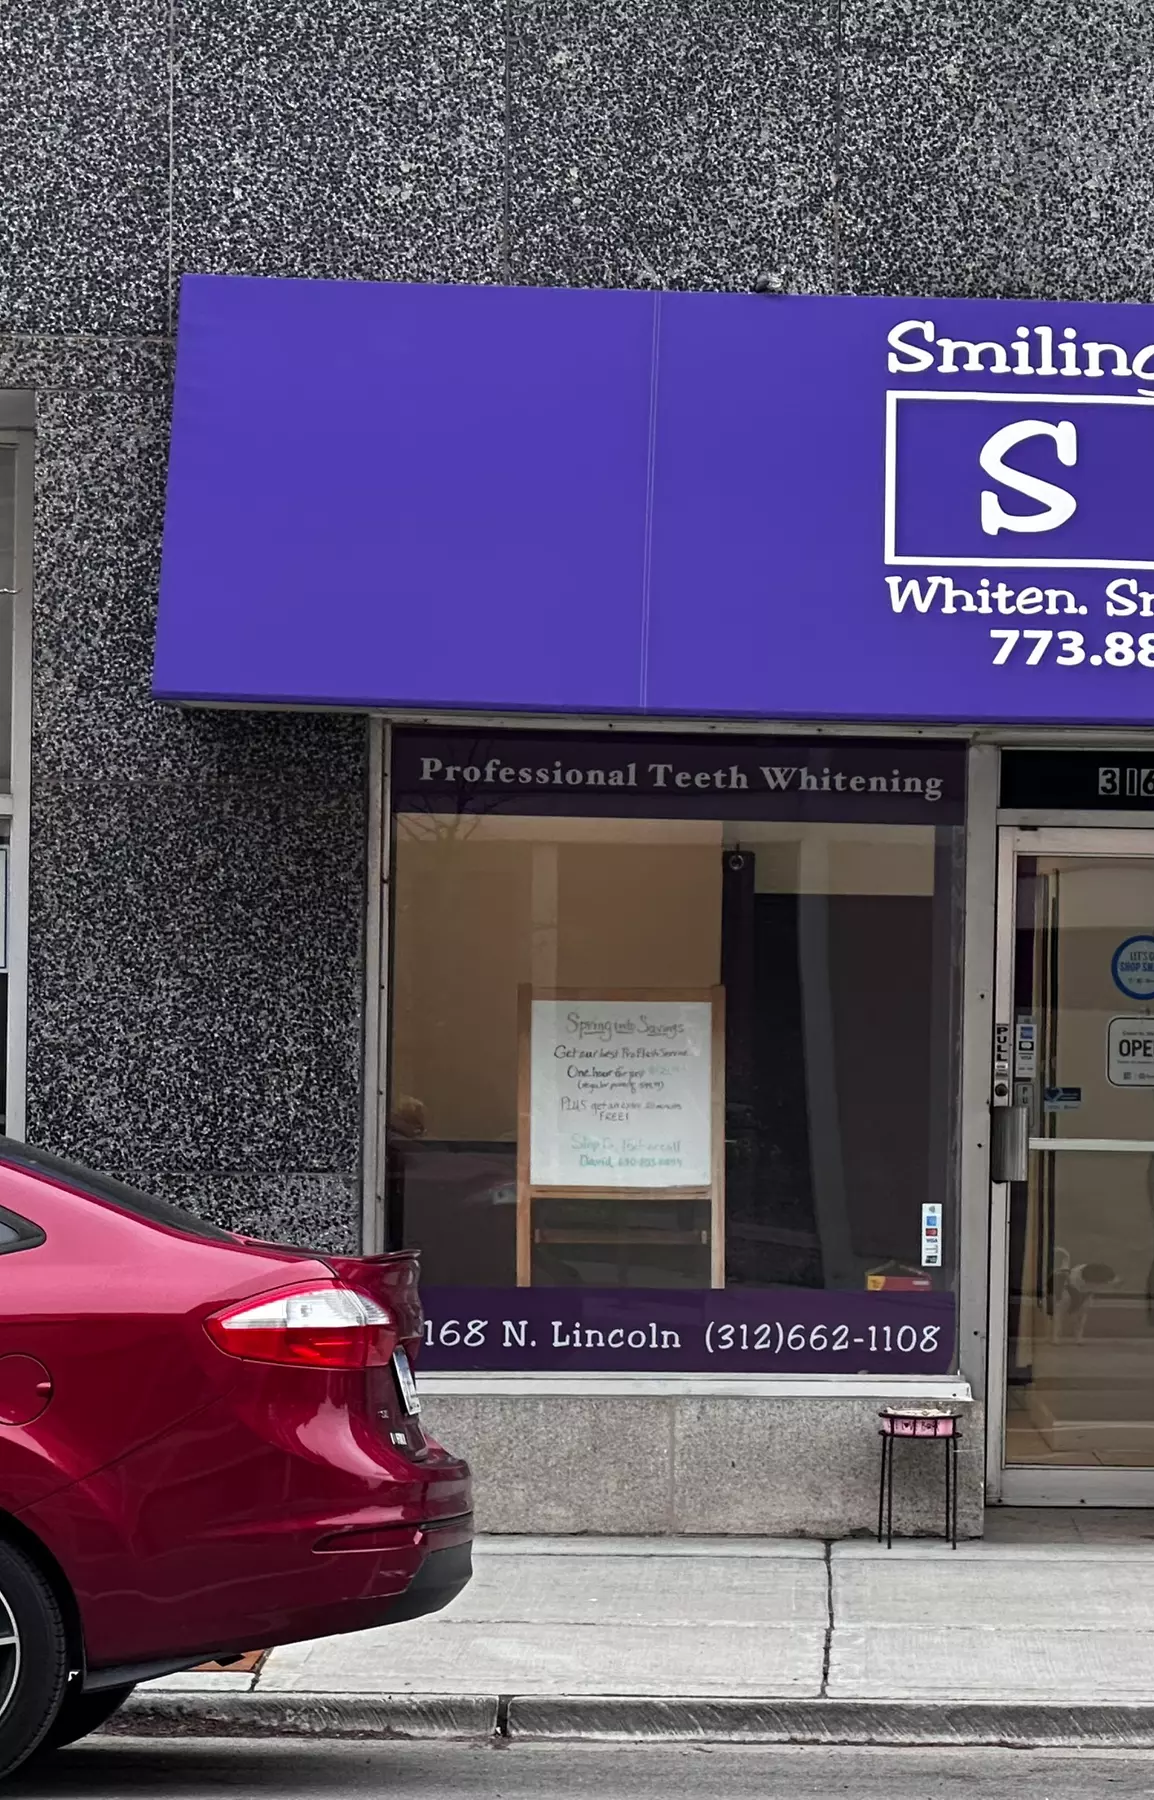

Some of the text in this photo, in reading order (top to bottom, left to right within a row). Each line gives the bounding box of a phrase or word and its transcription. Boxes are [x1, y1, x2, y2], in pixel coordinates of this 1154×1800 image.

[979, 420, 1077, 536] S
[885, 576, 1088, 615] Whiten.
[420, 757, 944, 801] Professional Teeth Whitening
[566, 1012, 613, 1041] Spring
[637, 1014, 685, 1040] Savings
[554, 1044, 576, 1059] Get
[996, 1026, 1009, 1062] PULL
[567, 1064, 590, 1079] One
[424, 1320, 941, 1353] 168 N. Lincoln (312)662-1108
